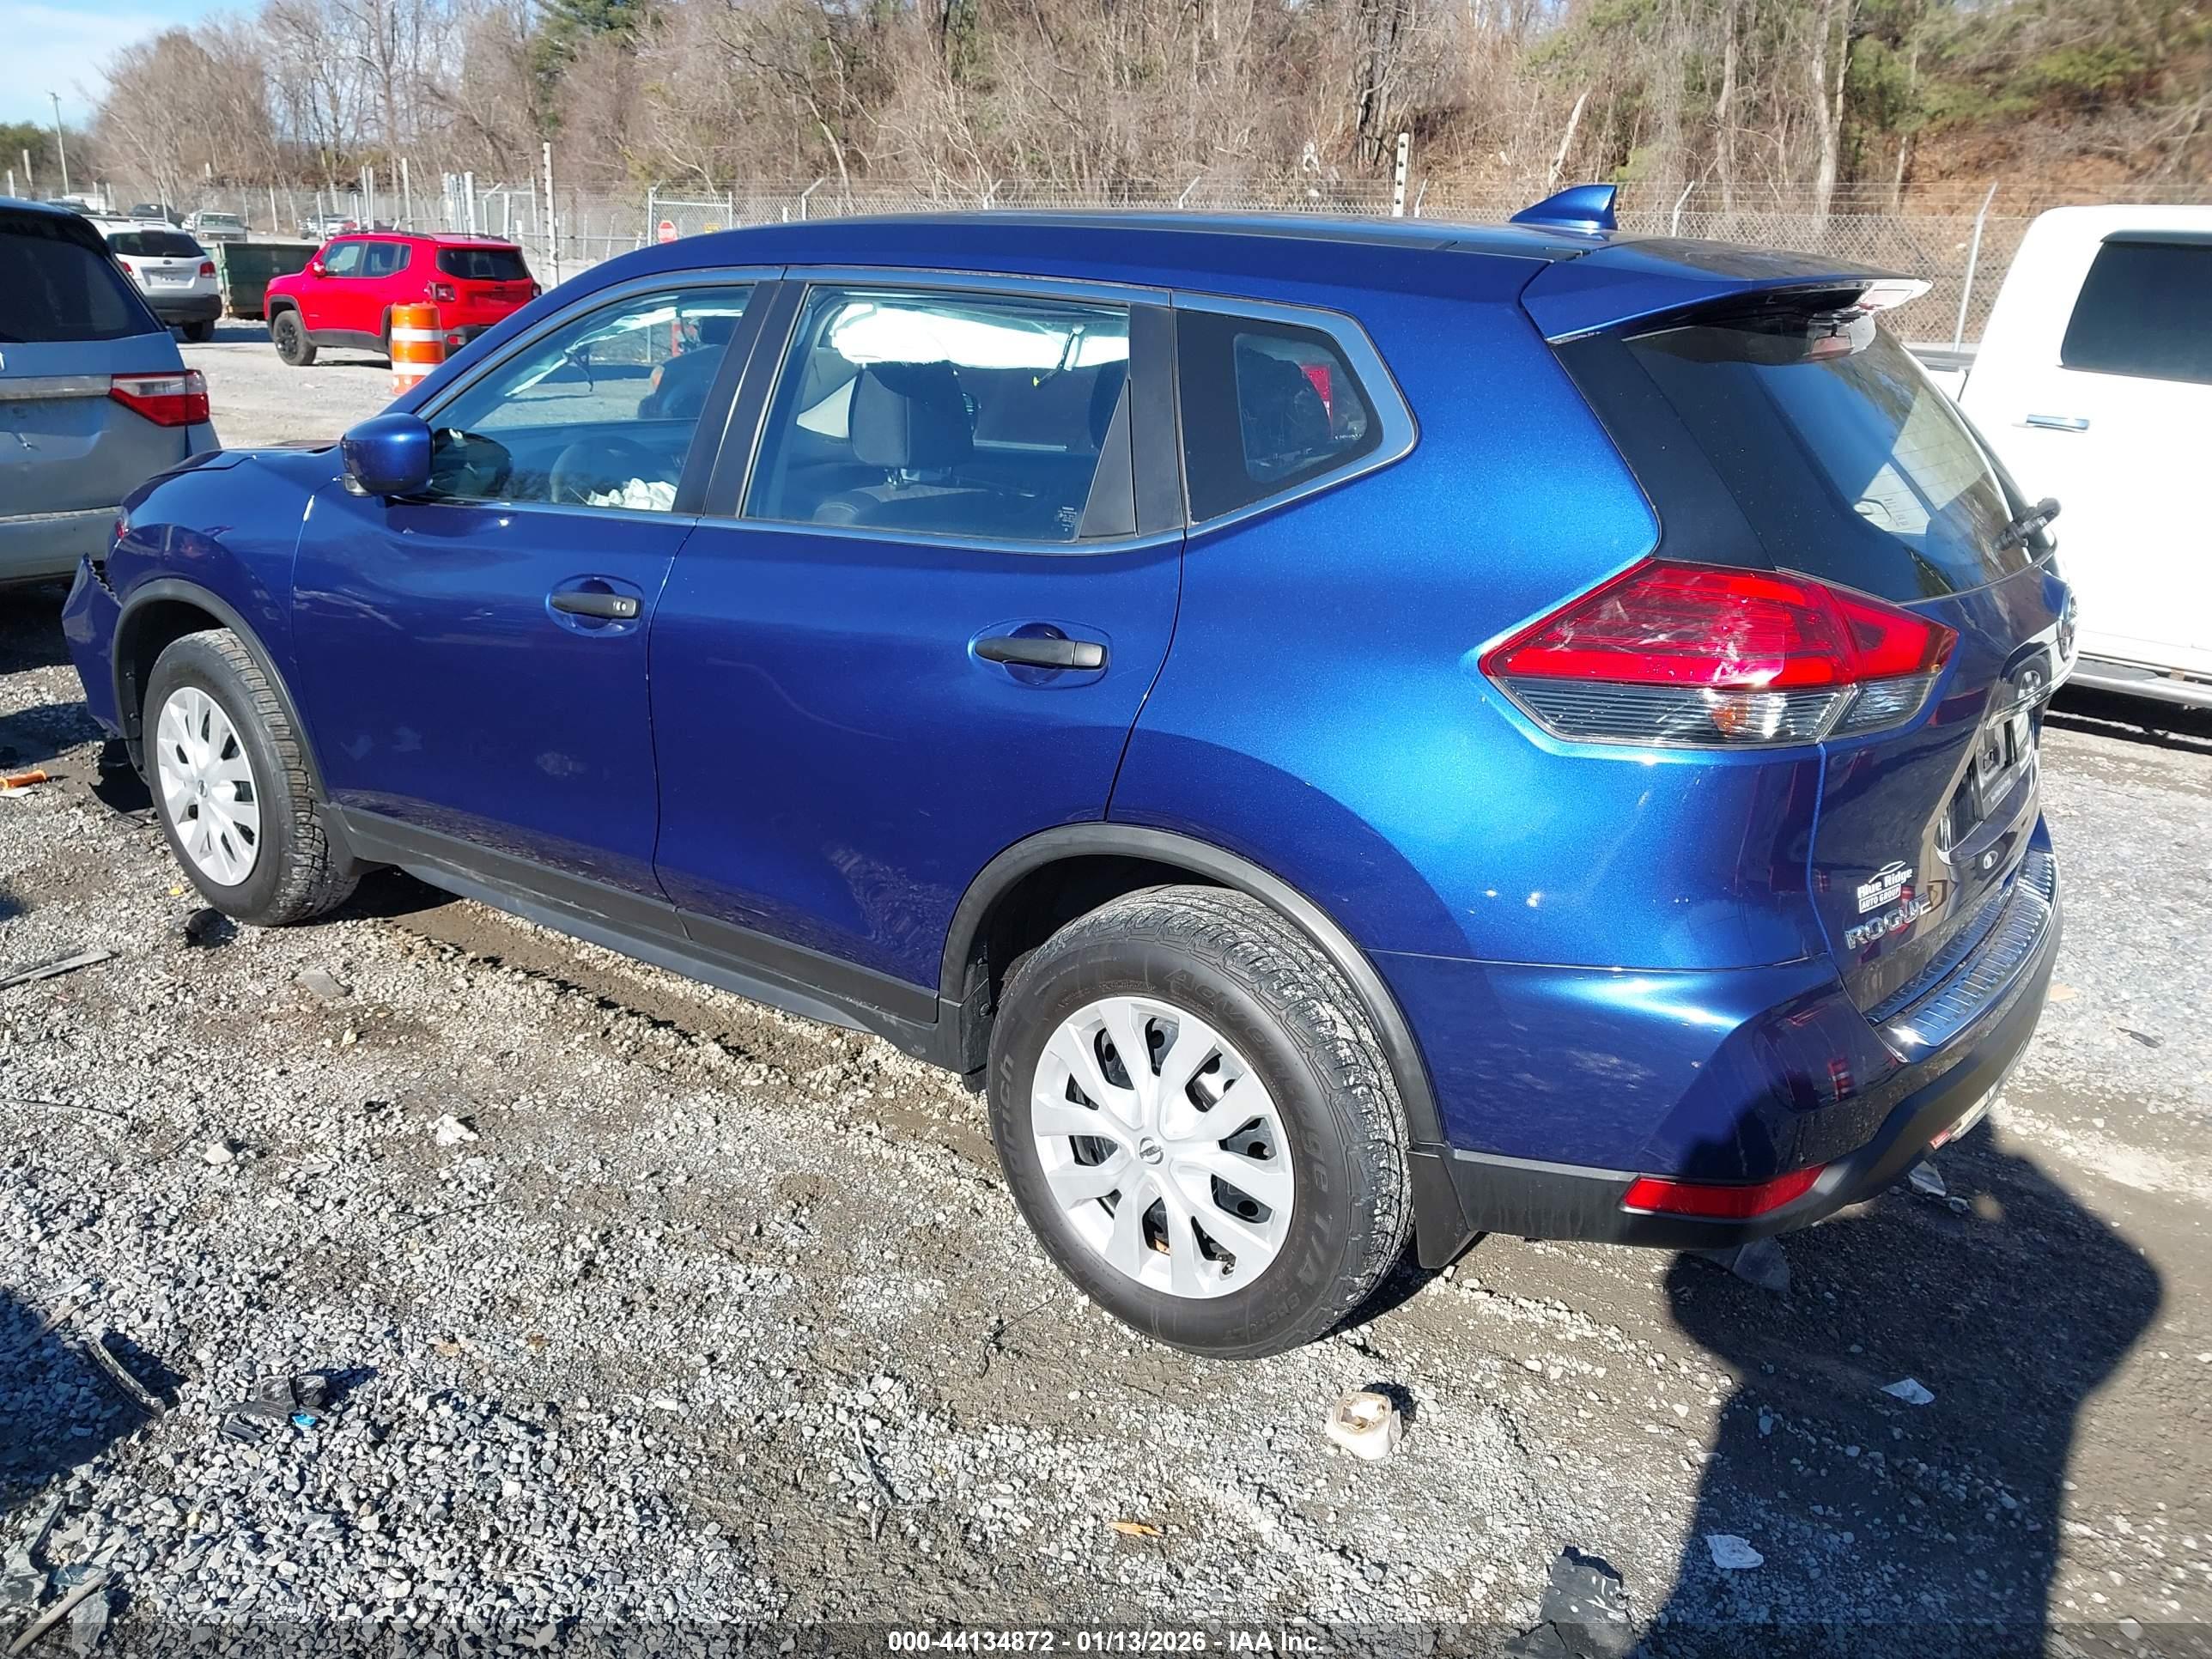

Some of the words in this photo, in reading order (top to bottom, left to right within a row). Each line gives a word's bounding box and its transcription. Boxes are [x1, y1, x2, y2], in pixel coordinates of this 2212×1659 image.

[1857, 881, 1882, 899] Blue
[1885, 868, 1912, 887] Ridge
[1861, 895, 1879, 910] AUTO
[1879, 886, 1900, 902] GROUP
[1844, 893, 1932, 950] ROGUE
